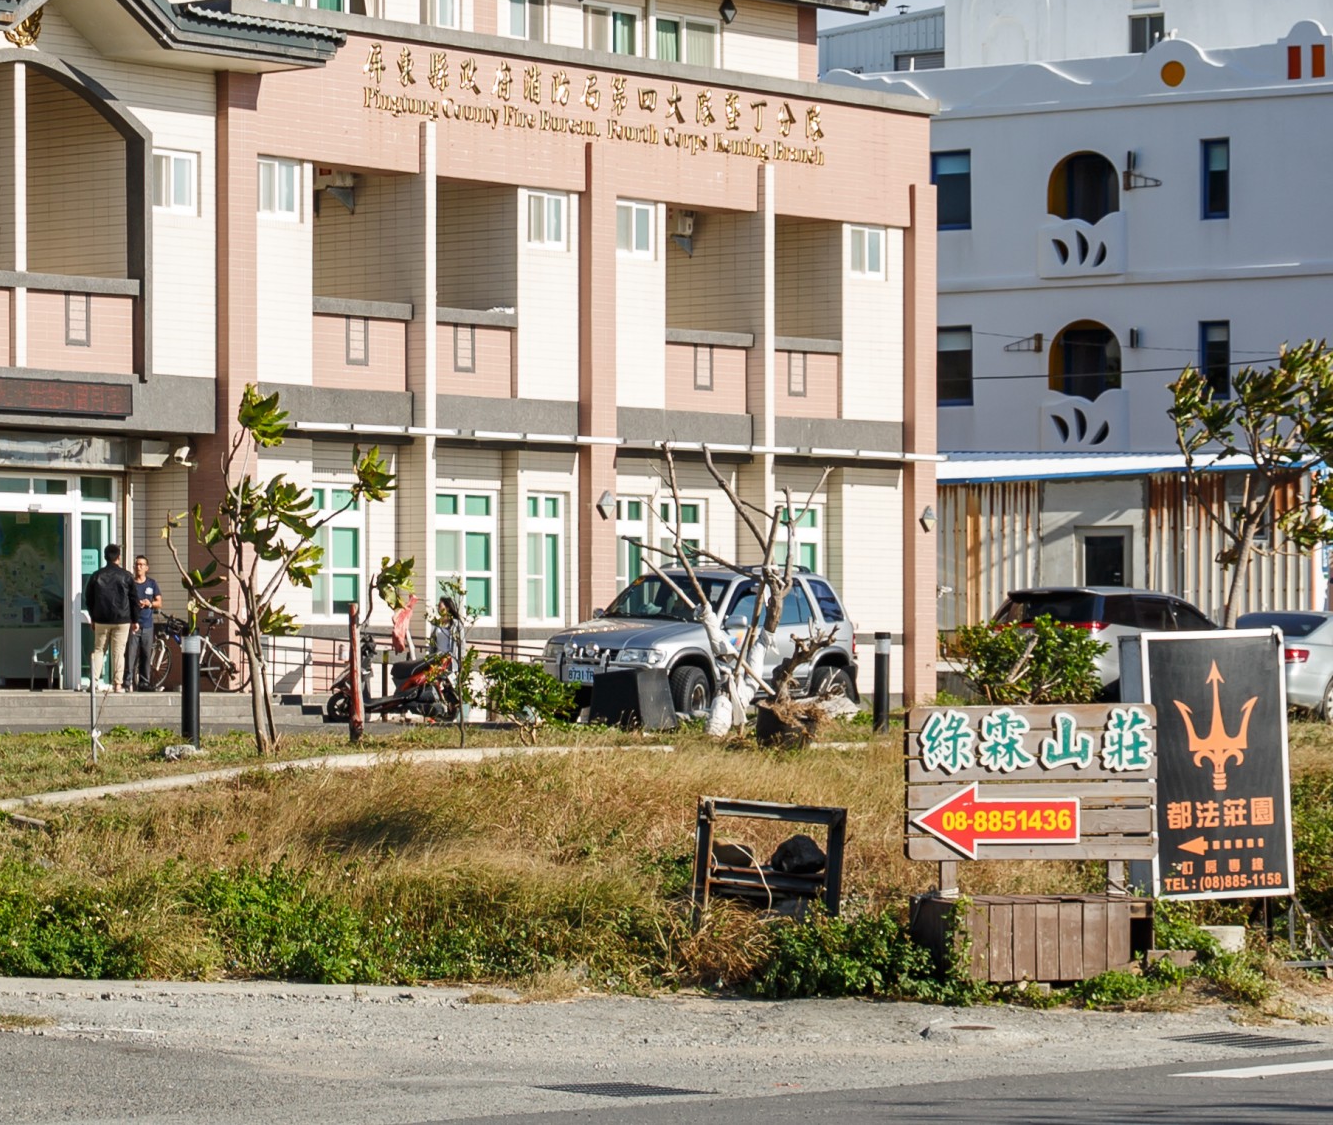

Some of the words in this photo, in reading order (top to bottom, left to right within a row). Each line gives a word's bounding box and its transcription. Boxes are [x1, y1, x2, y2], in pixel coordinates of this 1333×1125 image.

[363, 42, 824, 141] 屏東縣政府消防局第四大隊墾丁分隊
[363, 87, 439, 121] Pingtung
[442, 98, 499, 129] County
[503, 105, 536, 128] Fire
[607, 119, 659, 145] Fourth
[664, 126, 707, 155] Corps
[712, 132, 770, 162] Kenting
[773, 140, 825, 166] Branch
[920, 706, 1152, 773] 綠霖山莊
[942, 809, 1072, 832] 08-8851436
[1167, 797, 1274, 829] 都法莊園
